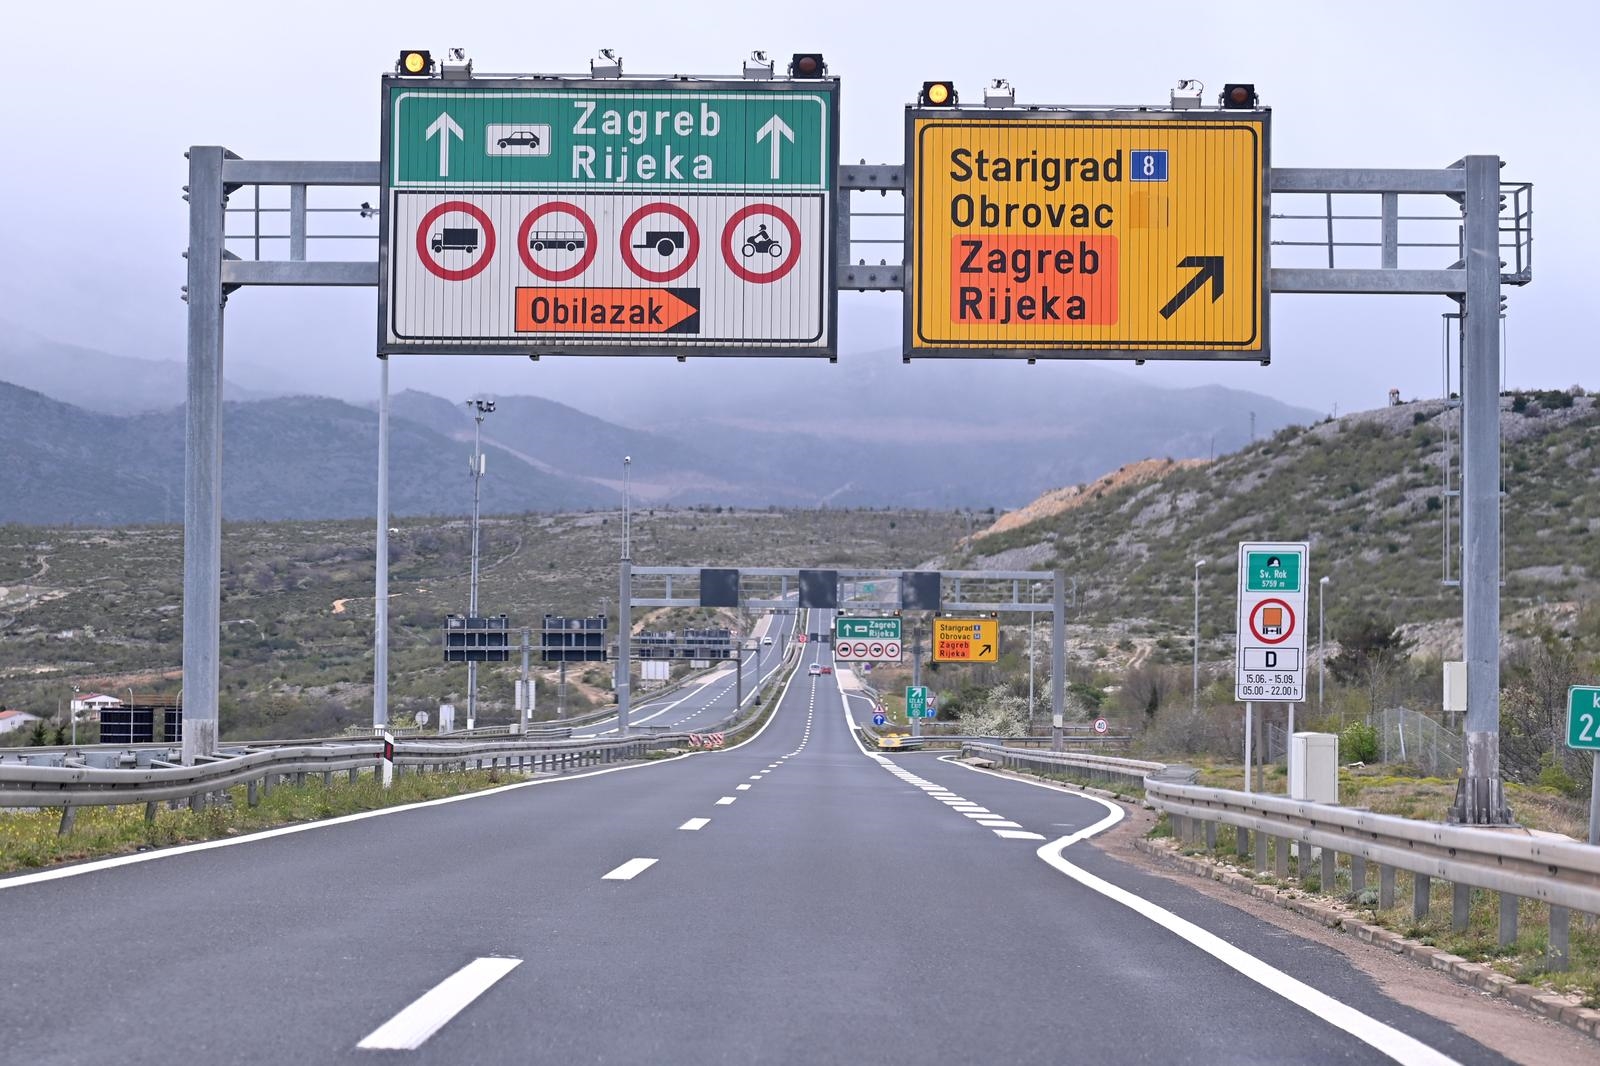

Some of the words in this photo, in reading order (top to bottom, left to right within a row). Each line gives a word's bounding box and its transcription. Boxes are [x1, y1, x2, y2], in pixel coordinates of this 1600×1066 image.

[572, 101, 721, 144] Zagreb
[571, 145, 714, 183] Rijeka
[950, 148, 1122, 191] Starigrad
[1143, 156, 1155, 176] 8
[951, 194, 1114, 228] Obrovac
[960, 240, 1100, 283] Zagreb
[531, 296, 663, 324] Obilazak
[959, 286, 1086, 324] Rijeka
[1260, 569, 1271, 579] Sv.
[1275, 569, 1287, 579] Rok
[1262, 580, 1278, 588] 5759
[869, 621, 896, 630] Zagreb
[940, 624, 973, 633] Starigrad
[869, 629, 895, 638] Rijeka
[940, 641, 969, 650] Zagreb
[940, 650, 966, 658] Rijeka
[1265, 651, 1277, 667] D
[1246, 674, 1267, 684] 15.06.
[1275, 674, 1295, 684] 15.09.
[1243, 685, 1264, 695] 05.00
[1271, 686, 1292, 696] 22.00
[1294, 686, 1298, 695] h
